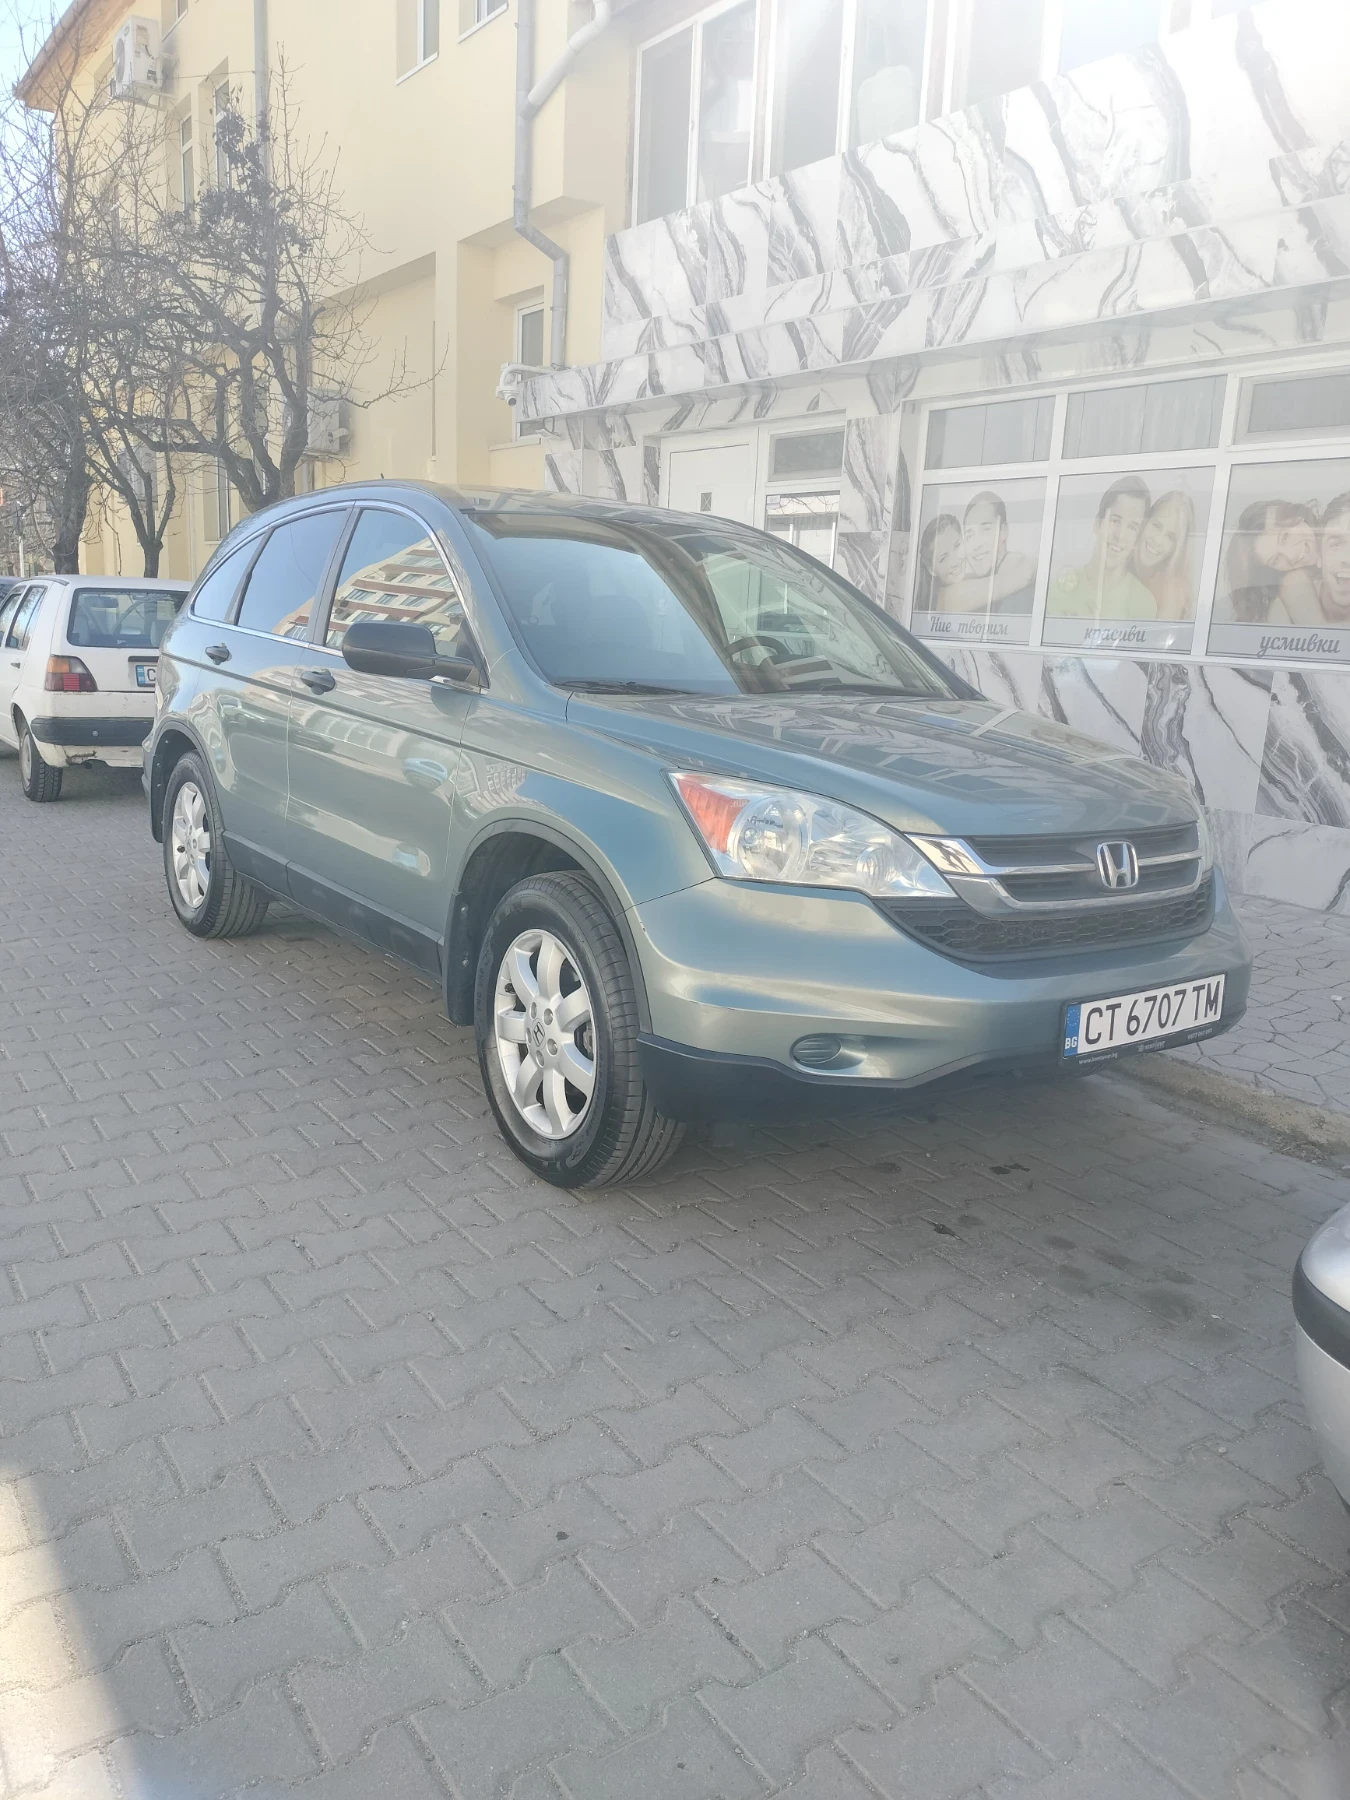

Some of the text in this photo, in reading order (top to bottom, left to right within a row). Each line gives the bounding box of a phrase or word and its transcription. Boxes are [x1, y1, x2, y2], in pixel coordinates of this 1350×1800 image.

[930, 616, 1009, 641] Ние творим
[1084, 625, 1147, 648] красиви
[1256, 633, 1341, 659] усмивки
[1084, 980, 1221, 1045] CT 6707 TM
[1064, 1036, 1078, 1050] BG
